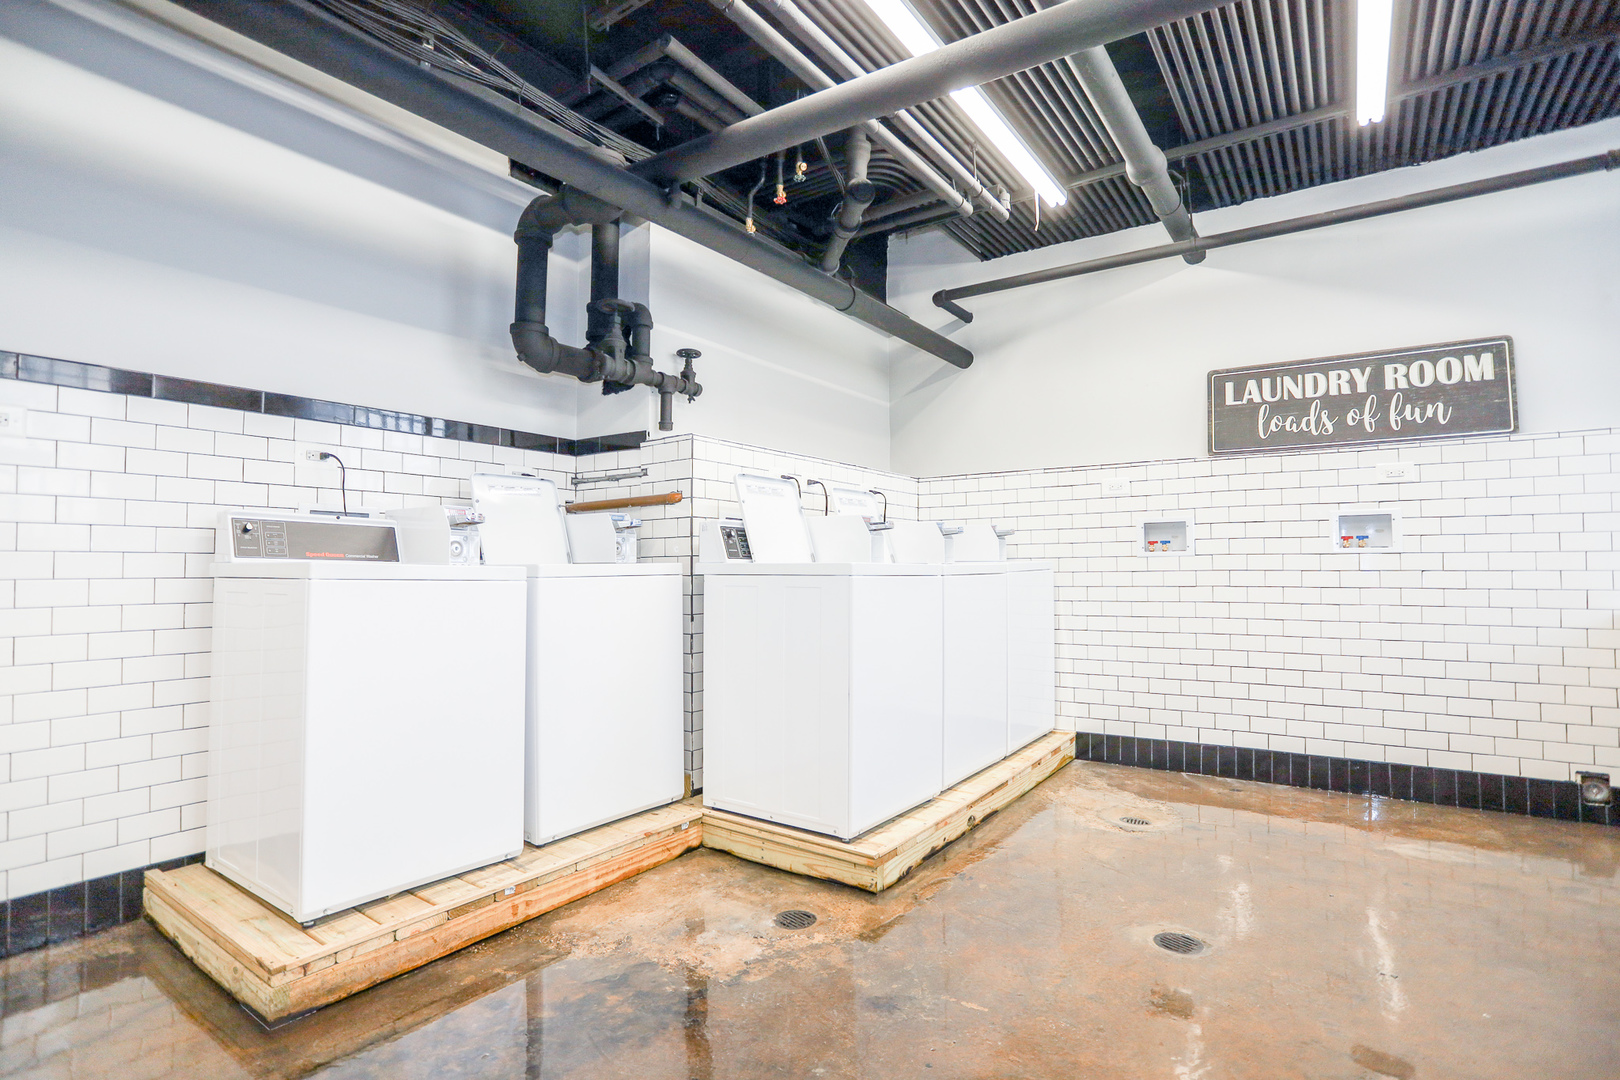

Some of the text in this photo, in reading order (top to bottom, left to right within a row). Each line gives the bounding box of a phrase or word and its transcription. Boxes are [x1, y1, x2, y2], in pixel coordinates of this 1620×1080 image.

[1225, 352, 1495, 406] LAUNDRY ROOM
[1258, 392, 1453, 439] loads of fun
